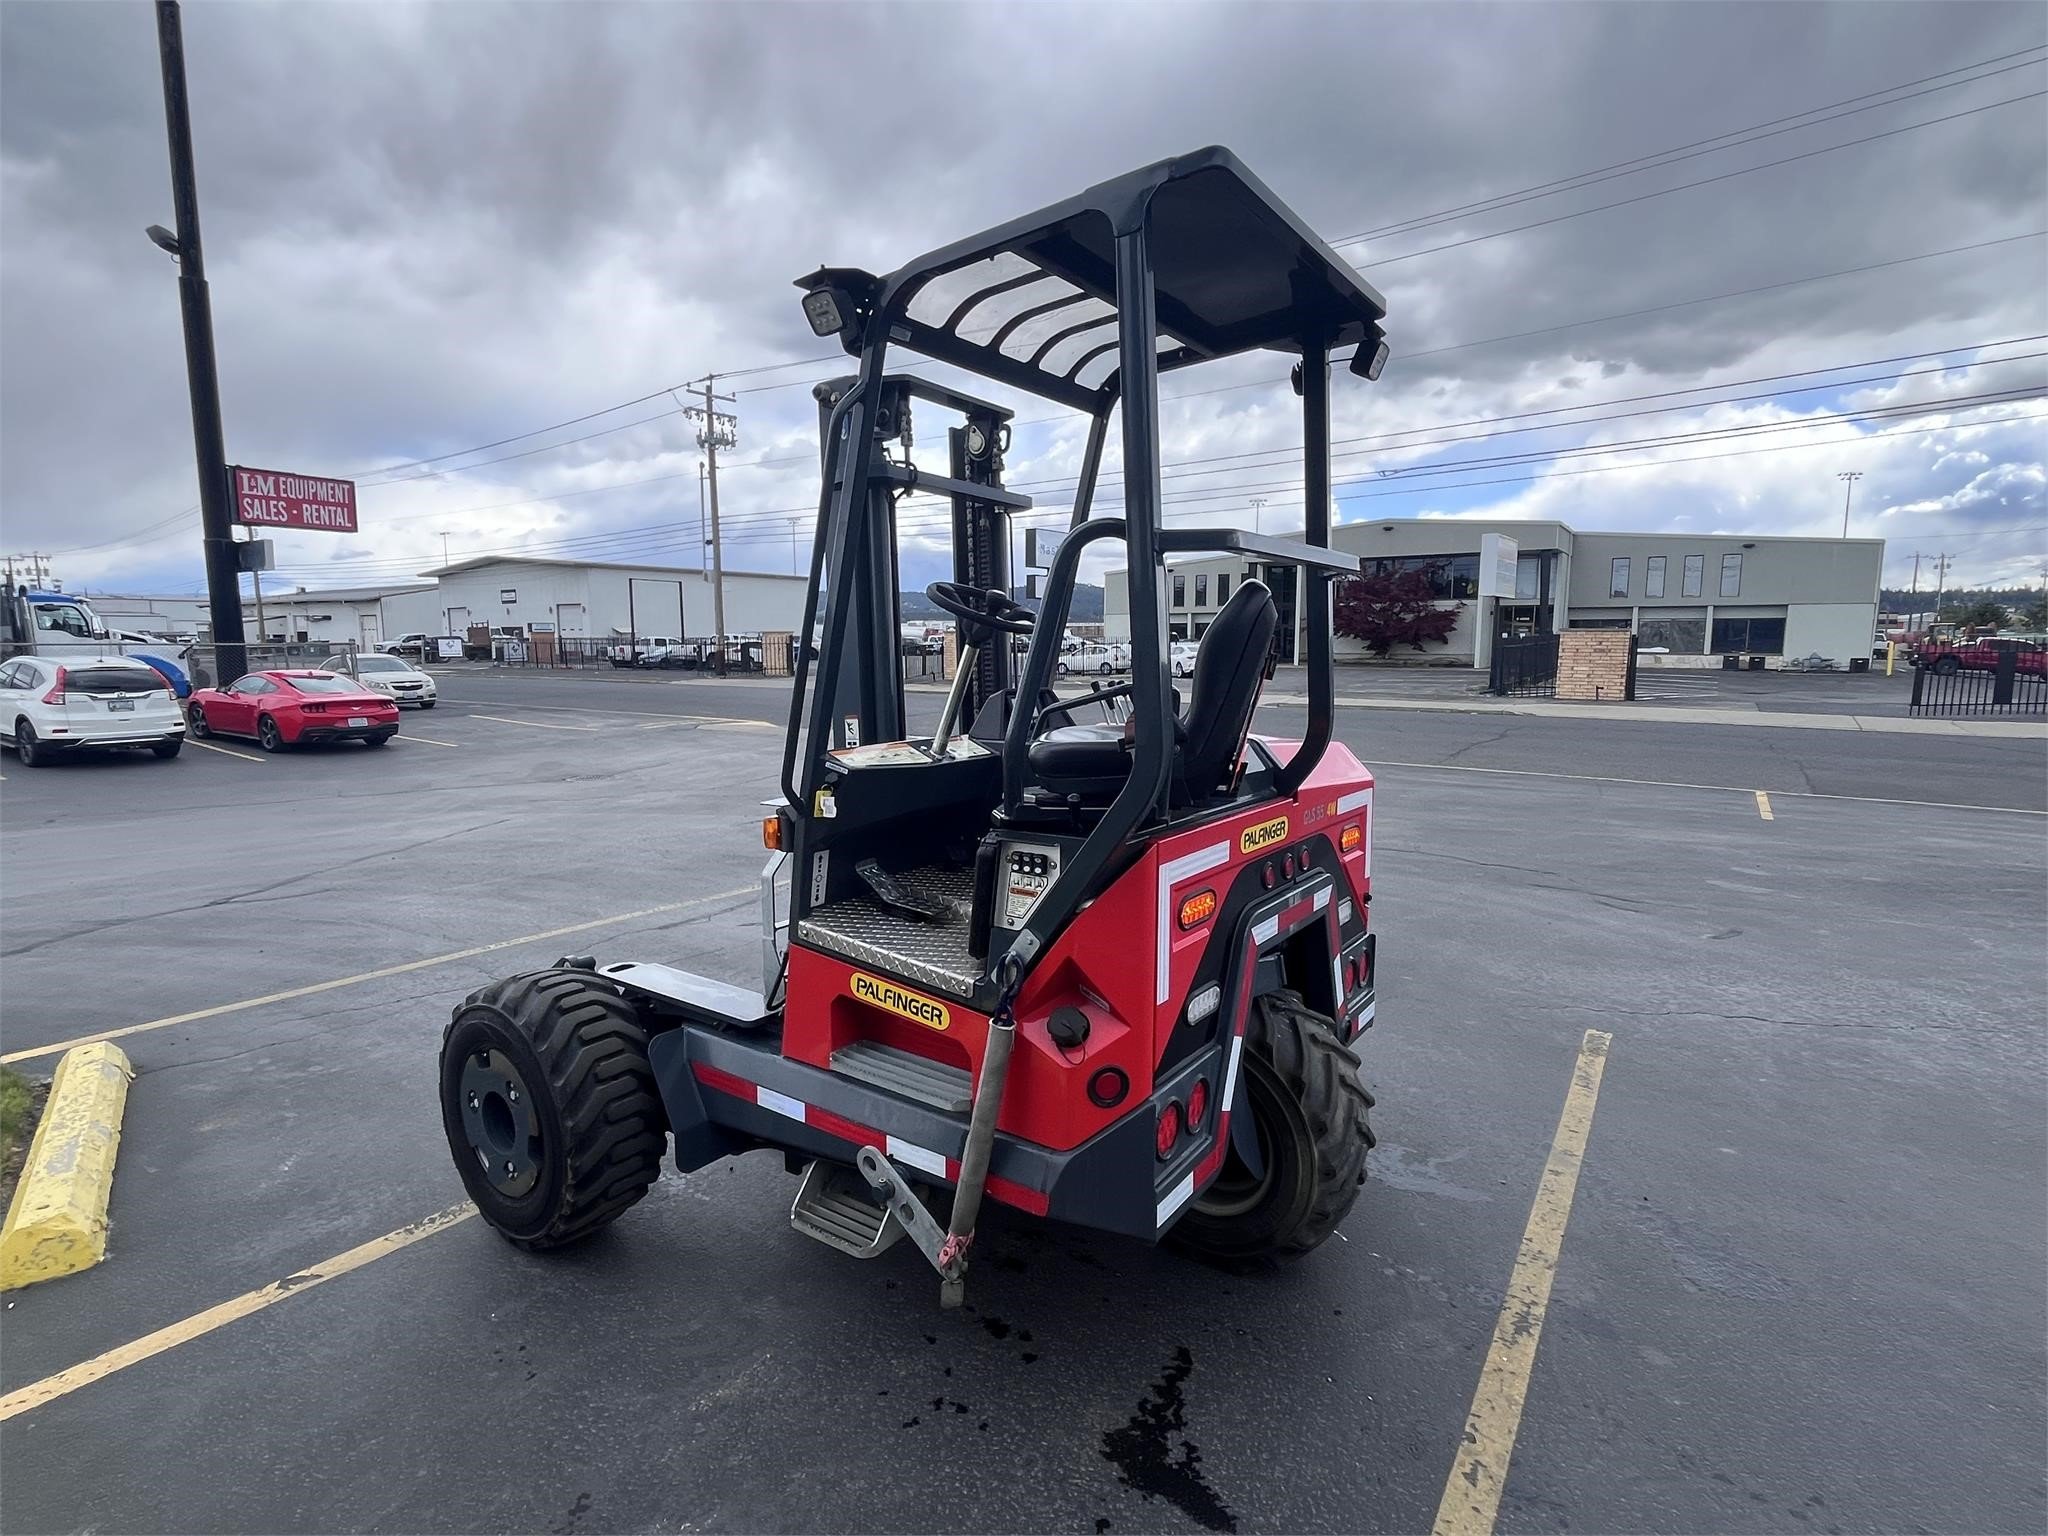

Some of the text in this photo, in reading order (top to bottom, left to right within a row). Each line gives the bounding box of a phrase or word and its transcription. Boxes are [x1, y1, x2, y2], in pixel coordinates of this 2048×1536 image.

[240, 472, 350, 504] L&M EQUIPMENT
[243, 498, 288, 522] SALES
[302, 503, 351, 527] RENTAL
[1243, 820, 1286, 850] PALFINGER
[856, 977, 943, 1026] PALFINGER
